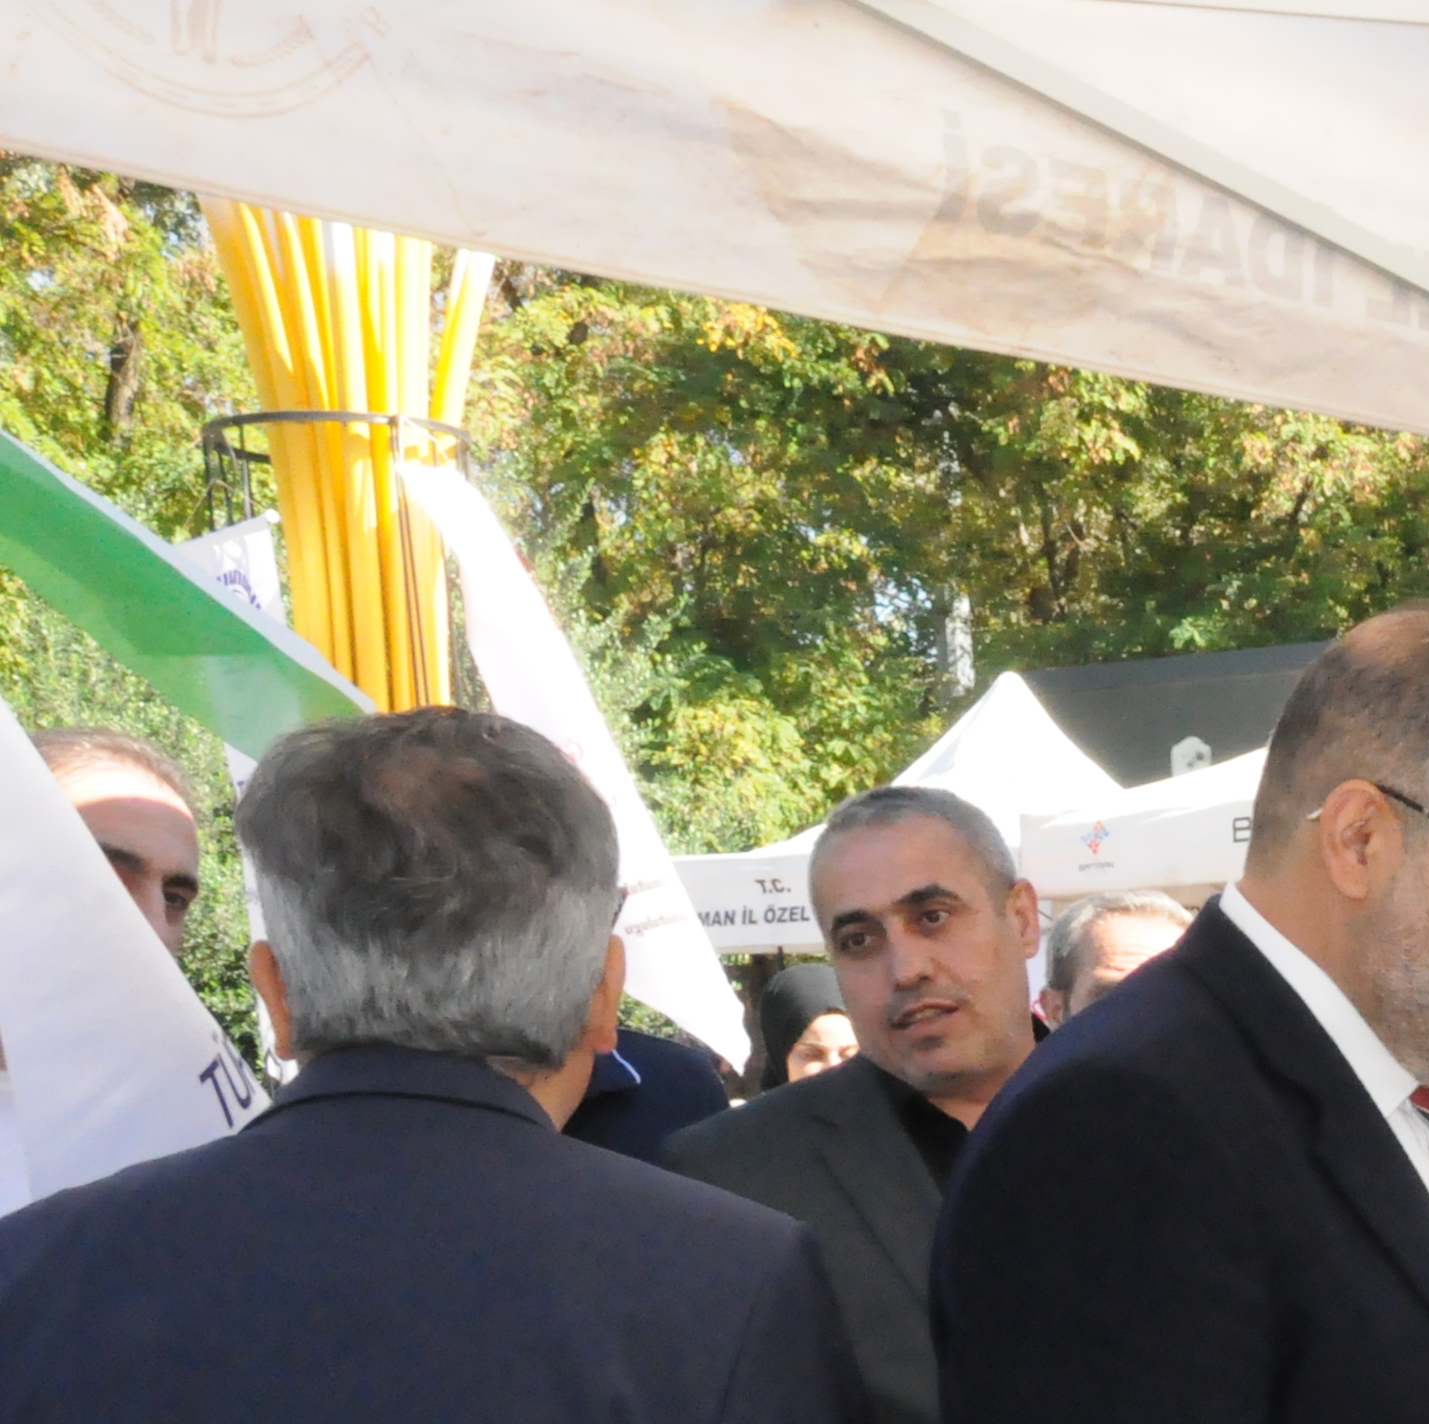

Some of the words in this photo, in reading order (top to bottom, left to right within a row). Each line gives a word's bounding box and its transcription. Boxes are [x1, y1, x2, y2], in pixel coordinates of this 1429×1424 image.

[753, 877, 792, 896] T.C.
[741, 905, 759, 926] İL
[763, 903, 811, 925] ÖZEL
